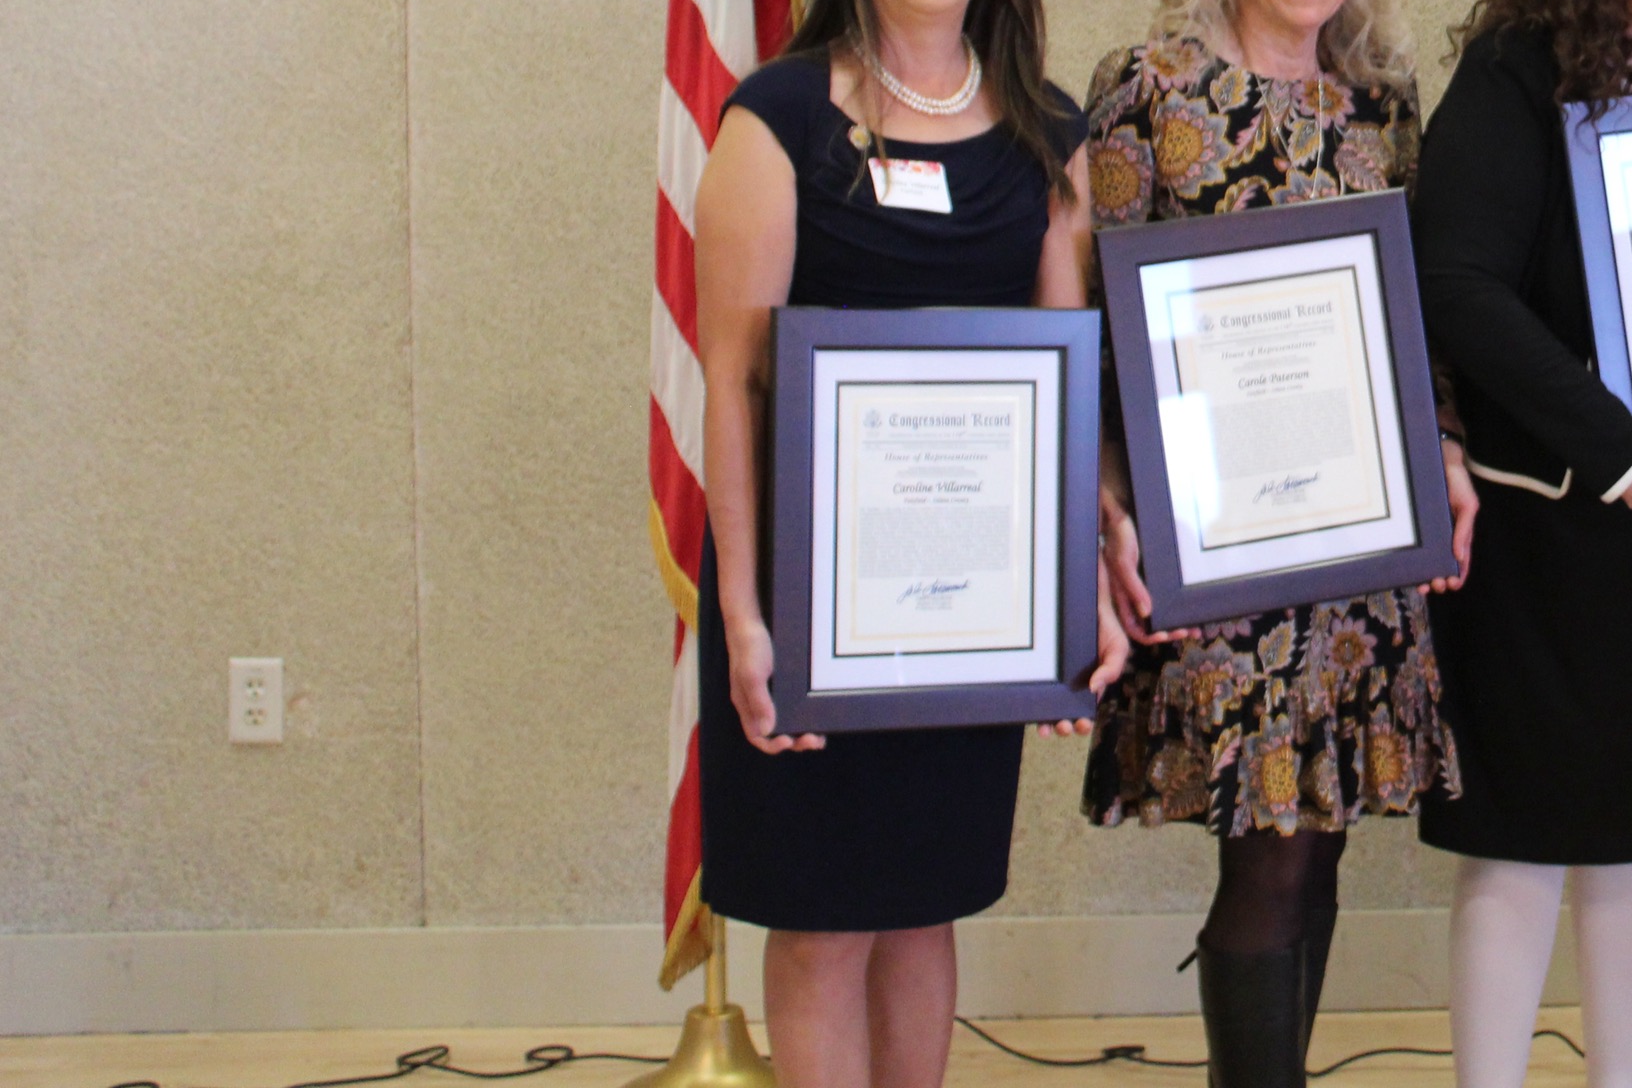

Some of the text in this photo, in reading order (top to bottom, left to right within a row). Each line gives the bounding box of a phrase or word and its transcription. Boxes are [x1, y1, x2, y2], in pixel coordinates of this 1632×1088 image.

[1221, 301, 1333, 328] Congressional Record
[889, 414, 1011, 431] Congressional Record
[893, 482, 934, 495] Caroline
